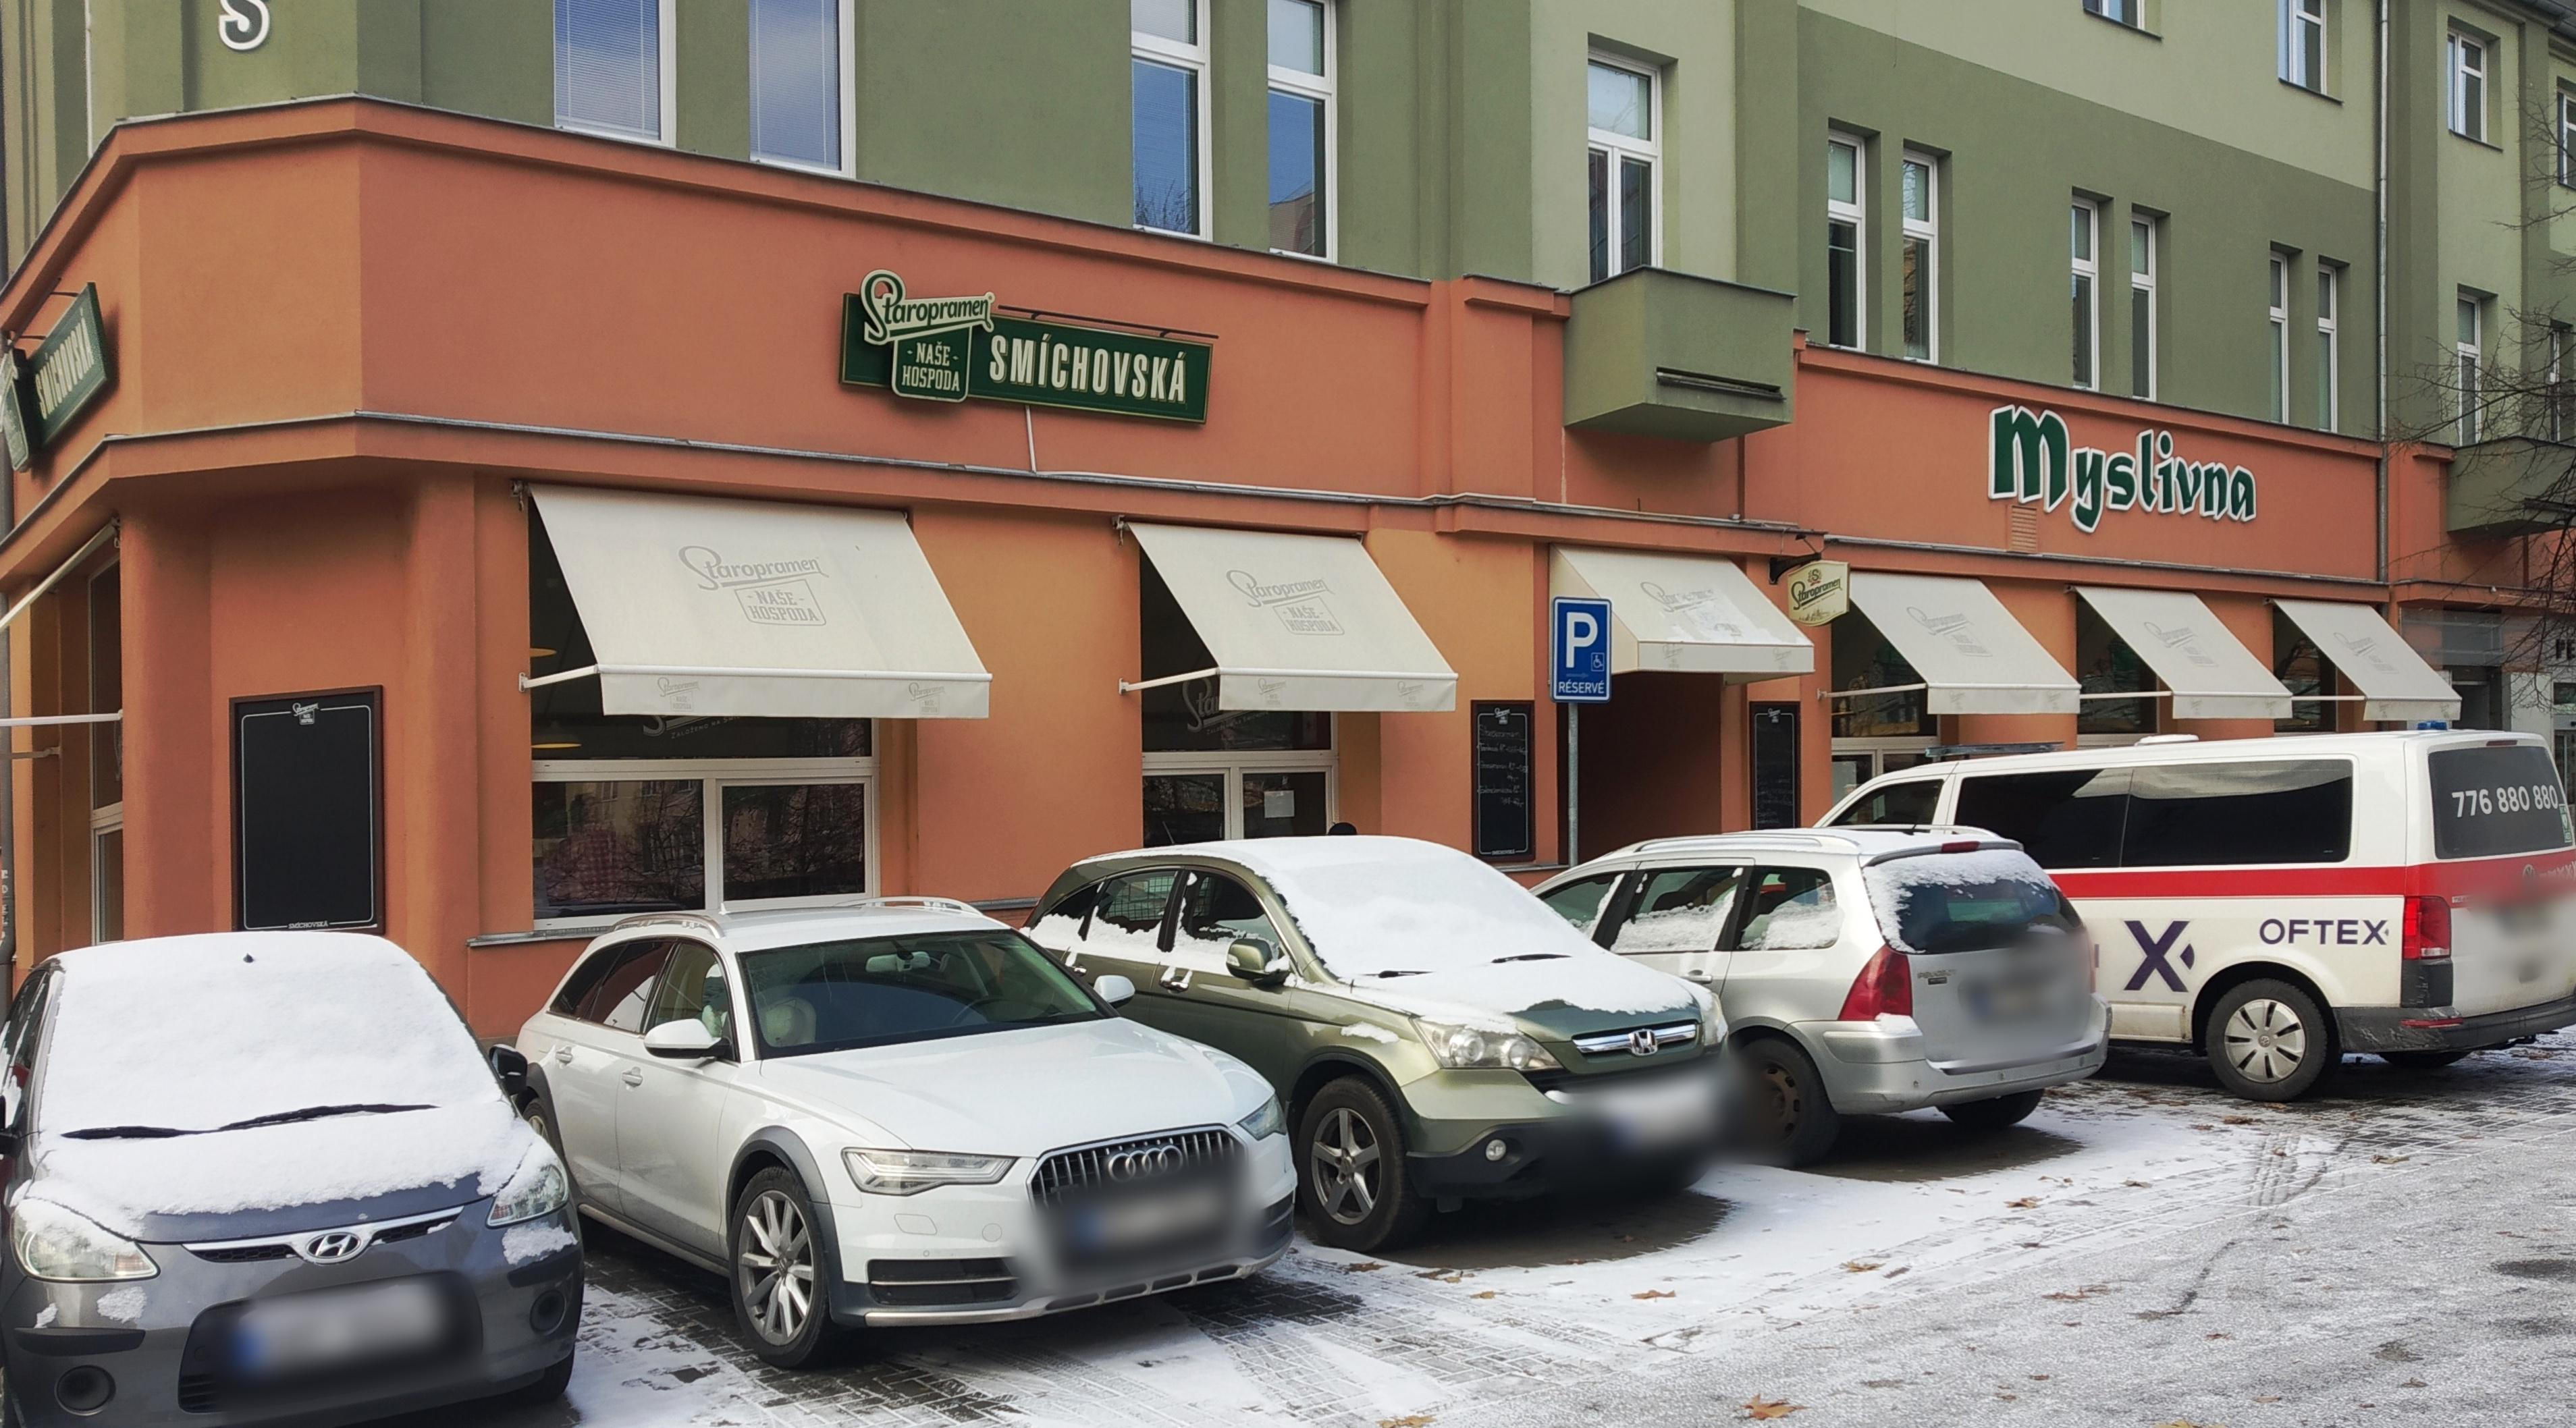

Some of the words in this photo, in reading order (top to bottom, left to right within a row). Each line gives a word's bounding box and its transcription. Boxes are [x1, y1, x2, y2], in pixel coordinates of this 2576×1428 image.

[863, 272, 992, 342] Staropramen
[915, 341, 950, 366] NAŠE
[901, 364, 960, 392] HOSPODA
[989, 333, 1186, 404] SMÍCHOVSKÁ
[1988, 404, 2257, 533] Myslivna
[678, 545, 830, 591] Staropramen
[754, 589, 798, 605] NAŠE
[1226, 570, 1336, 608] Staropramen
[1791, 580, 1843, 610] Staropramen
[747, 605, 820, 622] HOSPODA
[1285, 619, 1339, 632] HOSPODA
[1286, 605, 1320, 619] NAŠE
[1565, 611, 1599, 668] P
[1558, 679, 1605, 694] RÉSERVÉ
[2451, 789, 2492, 818] 776
[2496, 786, 2530, 813] 880
[2533, 784, 2558, 810] 880
[2259, 918, 2388, 945] OFTEX
